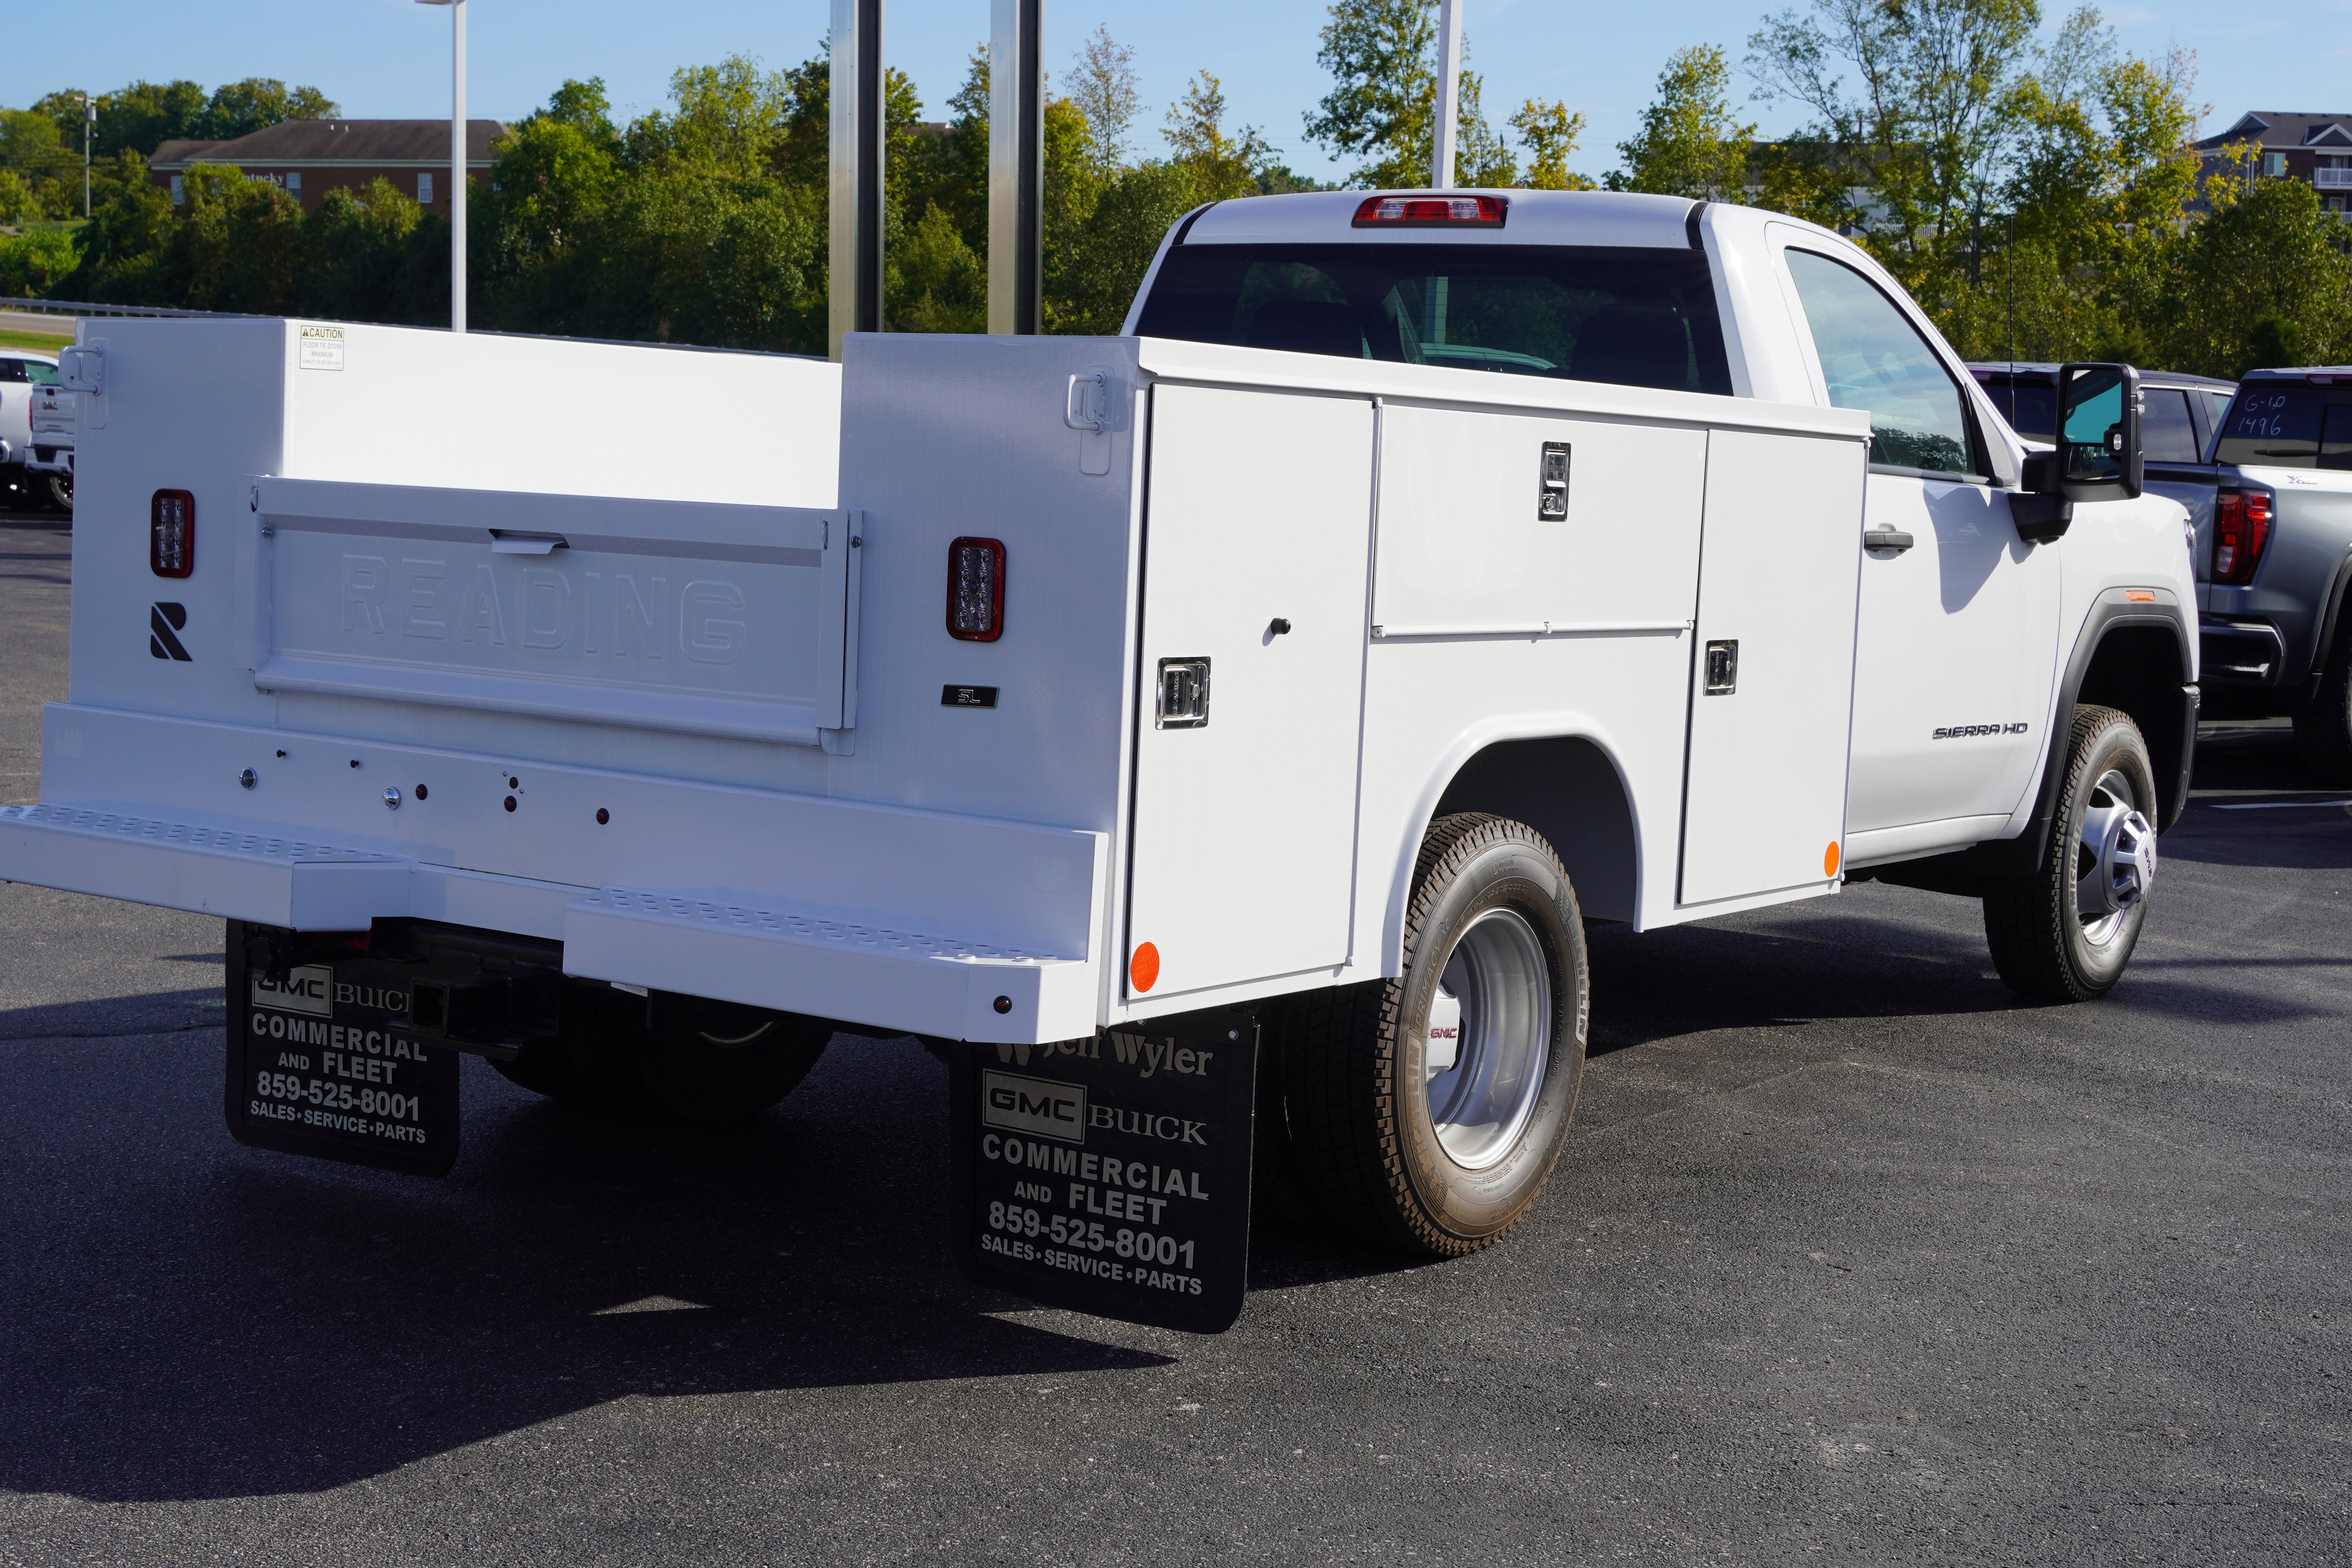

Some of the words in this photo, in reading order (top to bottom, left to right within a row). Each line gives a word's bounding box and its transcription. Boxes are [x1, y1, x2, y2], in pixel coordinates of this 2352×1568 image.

[244, 172, 284, 186] ntucky
[310, 328, 343, 339] CAUTION
[2239, 415, 2280, 435] 1496
[342, 553, 746, 666] READING
[958, 689, 980, 704] SL
[1932, 724, 2000, 739] SIERRA
[2002, 722, 2028, 734] HD
[2069, 815, 2082, 906] MICHELIN
[1414, 940, 1441, 1027] PRIMACY
[1568, 915, 1586, 1037] MICHELIN
[252, 1013, 427, 1062] COMMERCIAL
[1111, 1031, 1214, 1078] Wyler
[1430, 1027, 1457, 1039] GMC
[278, 1052, 310, 1070] AND
[323, 1051, 397, 1084] FLEET
[258, 1071, 419, 1121] 859-525-8001
[989, 1088, 1075, 1122] GMC
[1088, 1105, 1207, 1145] BUICK
[1408, 1044, 1436, 1174] MICHELIN
[983, 1134, 1209, 1200] COMMERCIAL
[1014, 1181, 1052, 1203] AND
[1069, 1182, 1167, 1225] FLEET
[989, 1201, 1194, 1269] 859-525-8001
